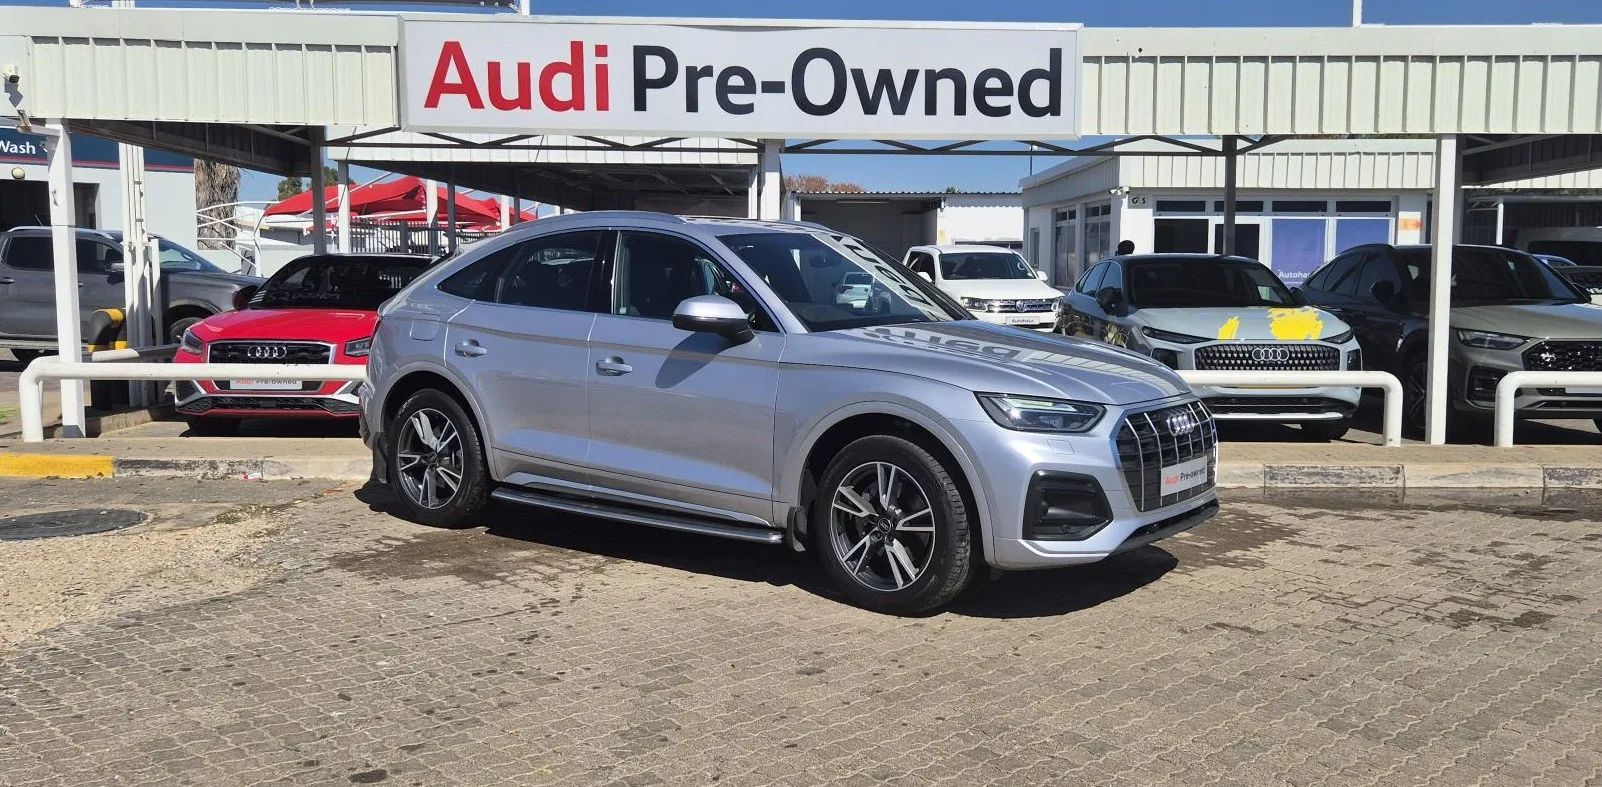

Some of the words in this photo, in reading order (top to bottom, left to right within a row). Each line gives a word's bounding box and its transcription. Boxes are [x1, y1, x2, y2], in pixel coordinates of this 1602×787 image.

[423, 40, 611, 112] Audi
[632, 44, 1063, 118] Pre-Owned
[0, 140, 36, 155] Wash
[1165, 473, 1179, 484] Audi
